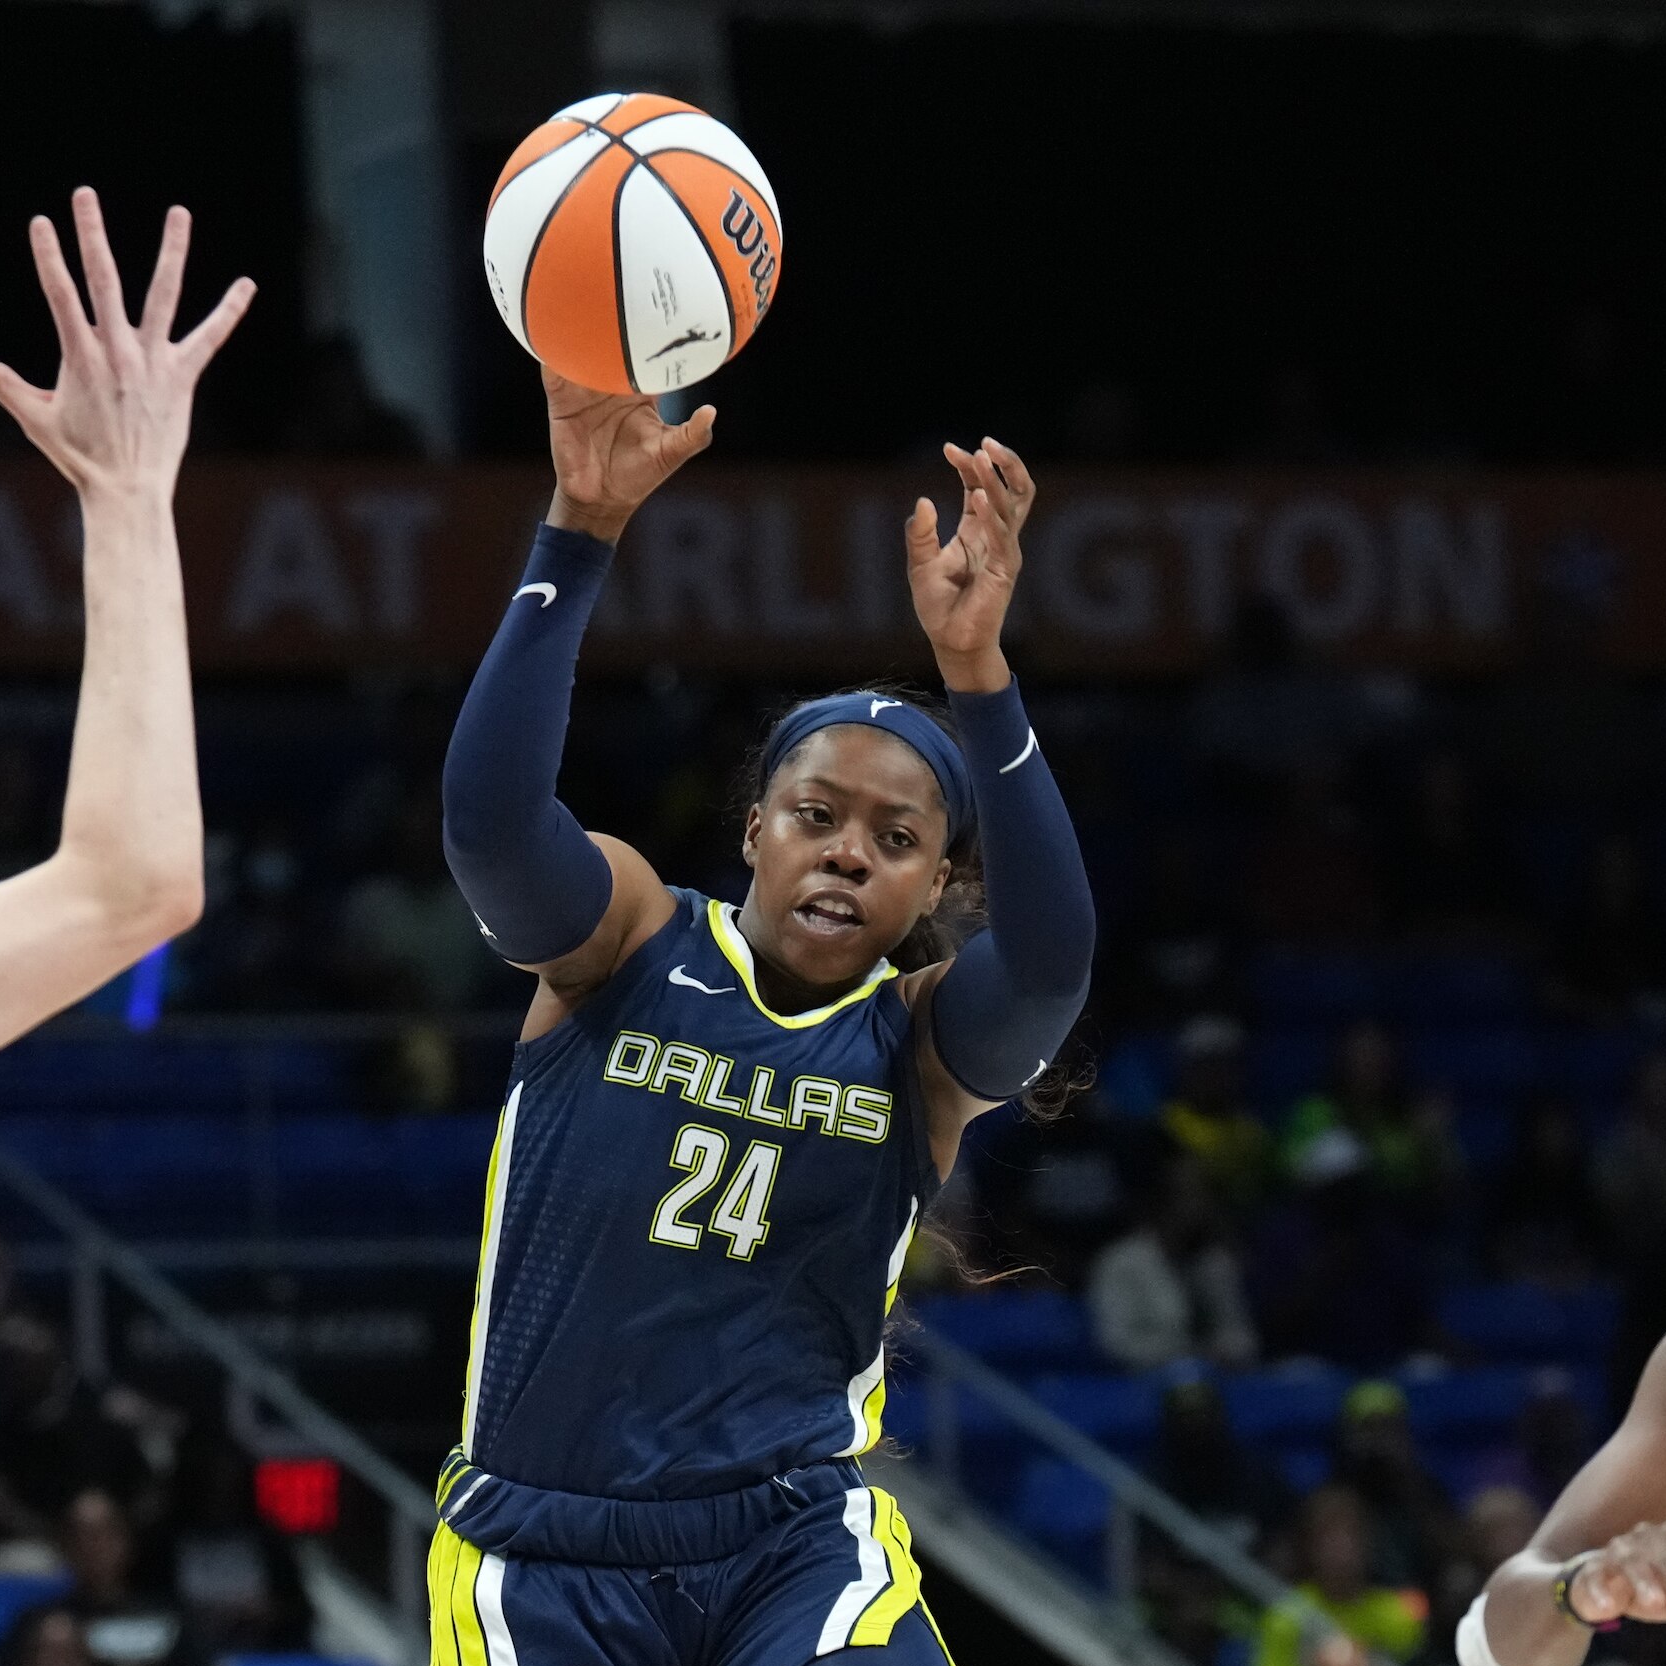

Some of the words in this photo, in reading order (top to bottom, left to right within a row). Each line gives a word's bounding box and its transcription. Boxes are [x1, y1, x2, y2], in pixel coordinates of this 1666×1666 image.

[721, 187, 776, 333] Wils
[221, 487, 443, 634] AT
[593, 490, 1515, 642] RLIGTON
[603, 1030, 893, 1144] DALLAS
[649, 1123, 782, 1262] 24
